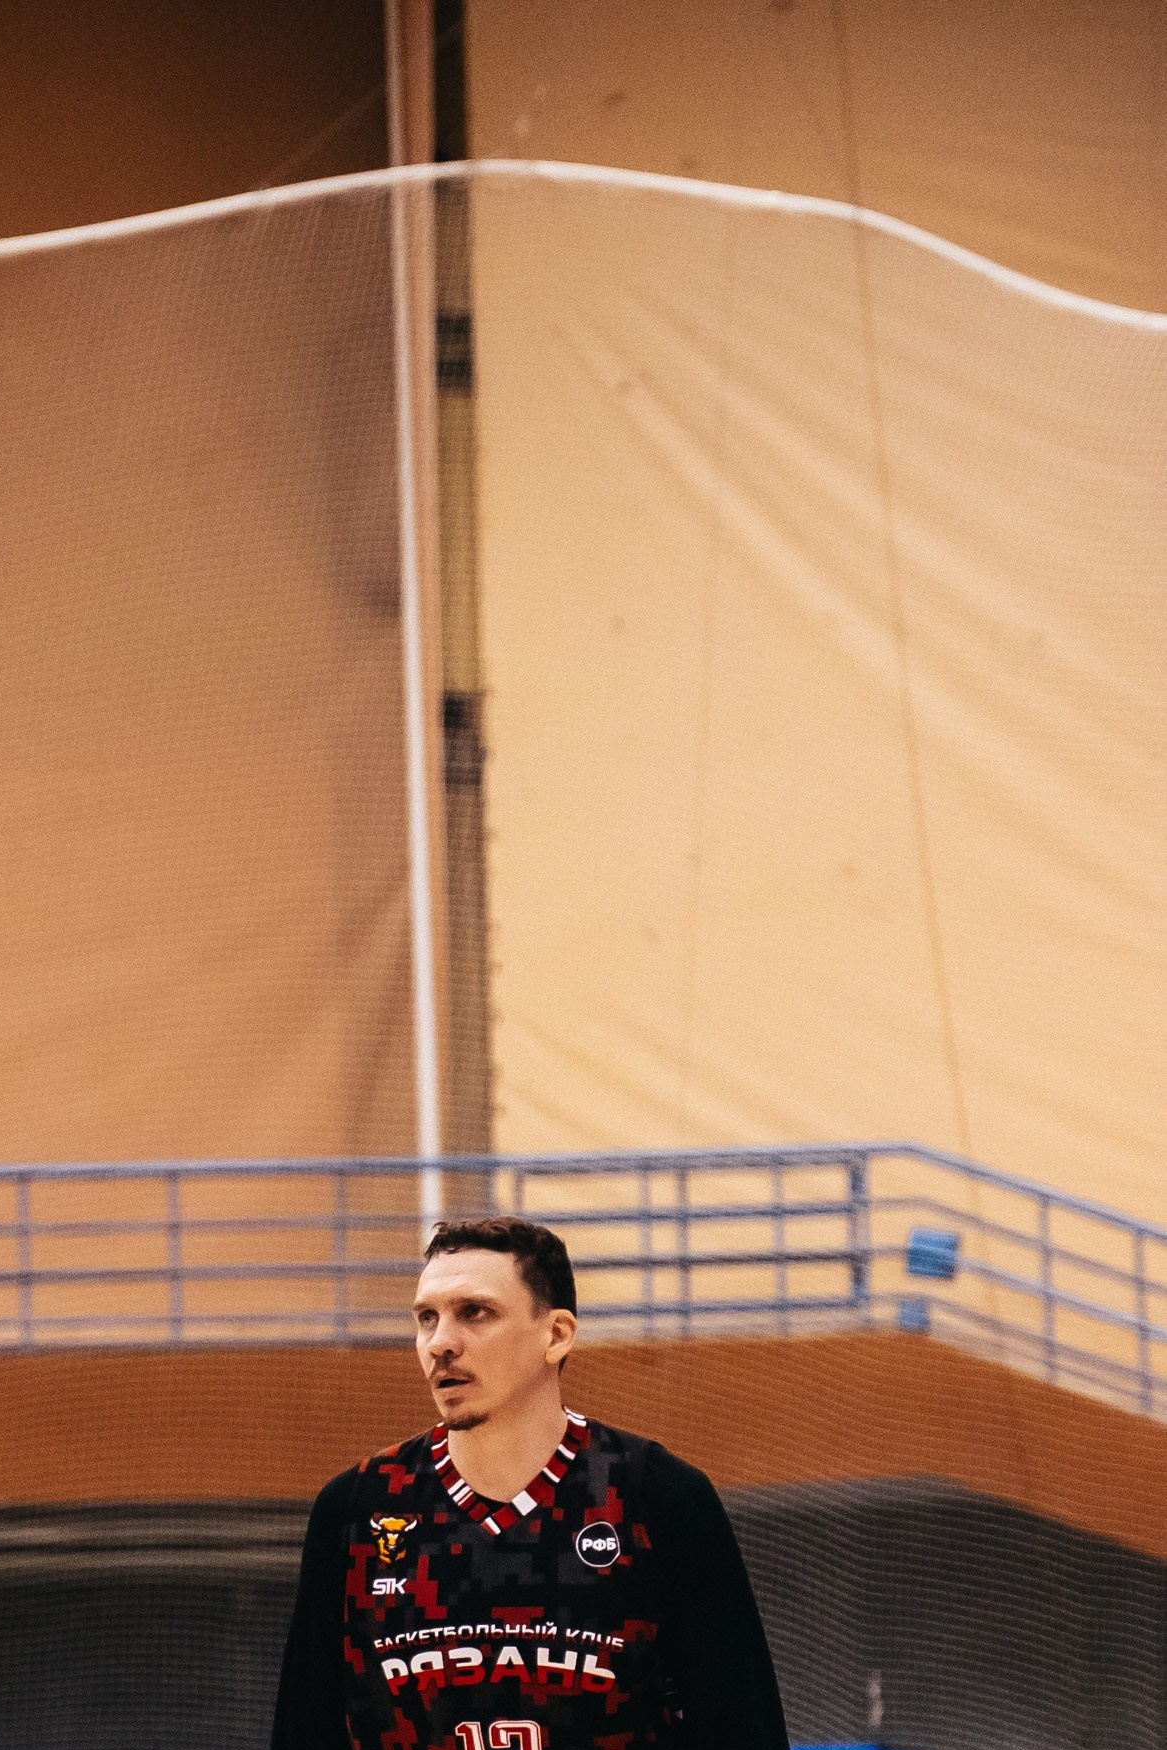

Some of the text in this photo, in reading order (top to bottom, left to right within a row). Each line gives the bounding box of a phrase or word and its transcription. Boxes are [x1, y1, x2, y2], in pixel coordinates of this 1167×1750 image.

[582, 1537, 617, 1552] РФБ
[371, 1577, 408, 1596] STK
[373, 1621, 626, 1653] БАСКЕТБОЛЬНЫЙ КЛУБ
[381, 1646, 617, 1696] РЯЗАНЬ
